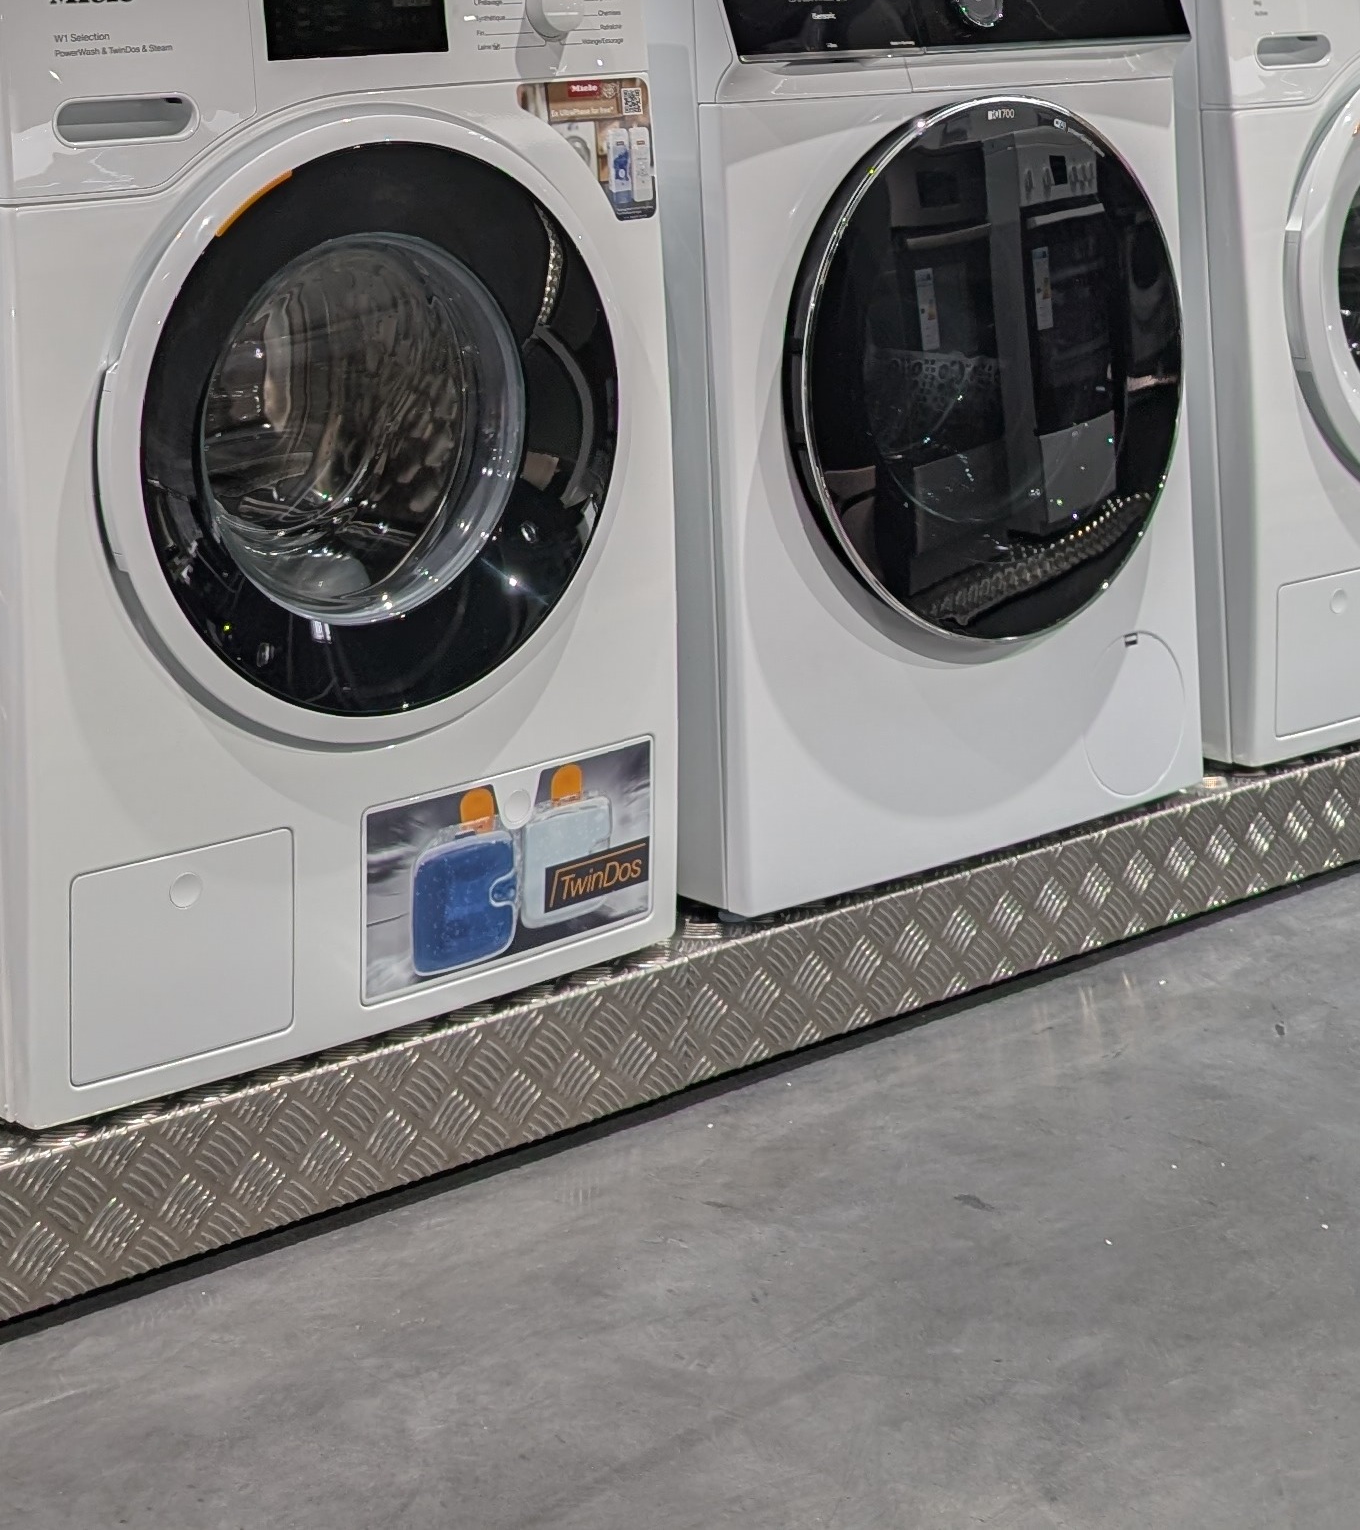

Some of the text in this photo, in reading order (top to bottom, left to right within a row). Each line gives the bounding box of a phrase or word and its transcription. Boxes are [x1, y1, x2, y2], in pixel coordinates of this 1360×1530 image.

[53, 32, 110, 43] W1 Selection
[54, 44, 173, 57] PowerWash & TwinDos & Steam
[570, 84, 598, 93] Miele
[559, 858, 643, 901] TwinDos
